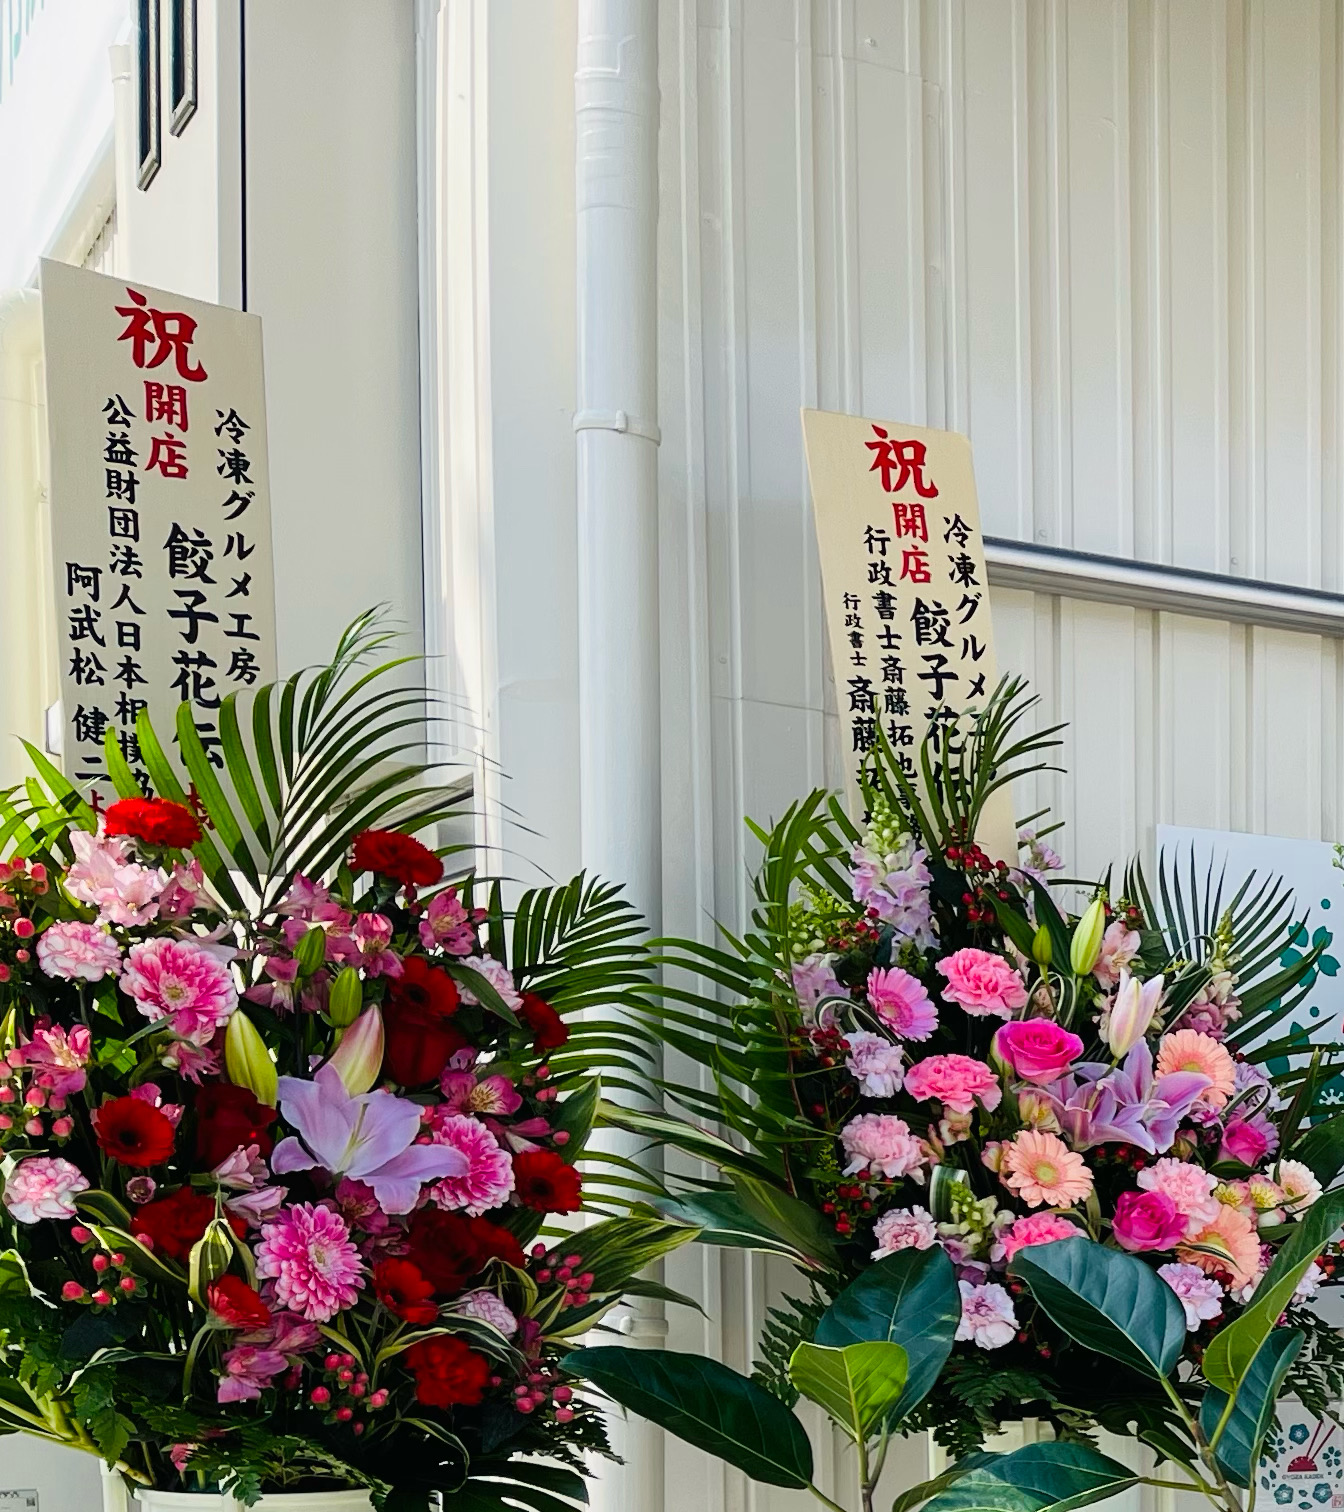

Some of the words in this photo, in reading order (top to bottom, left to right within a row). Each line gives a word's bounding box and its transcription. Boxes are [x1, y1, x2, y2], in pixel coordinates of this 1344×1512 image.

[115, 287, 208, 480] 祝開店
[214, 407, 261, 686] 冷凍グルメ工房
[865, 424, 938, 584] 祝開店
[65, 562, 108, 688] 阿武松
[842, 591, 868, 667] 行政書士
[71, 703, 112, 784] 健二
